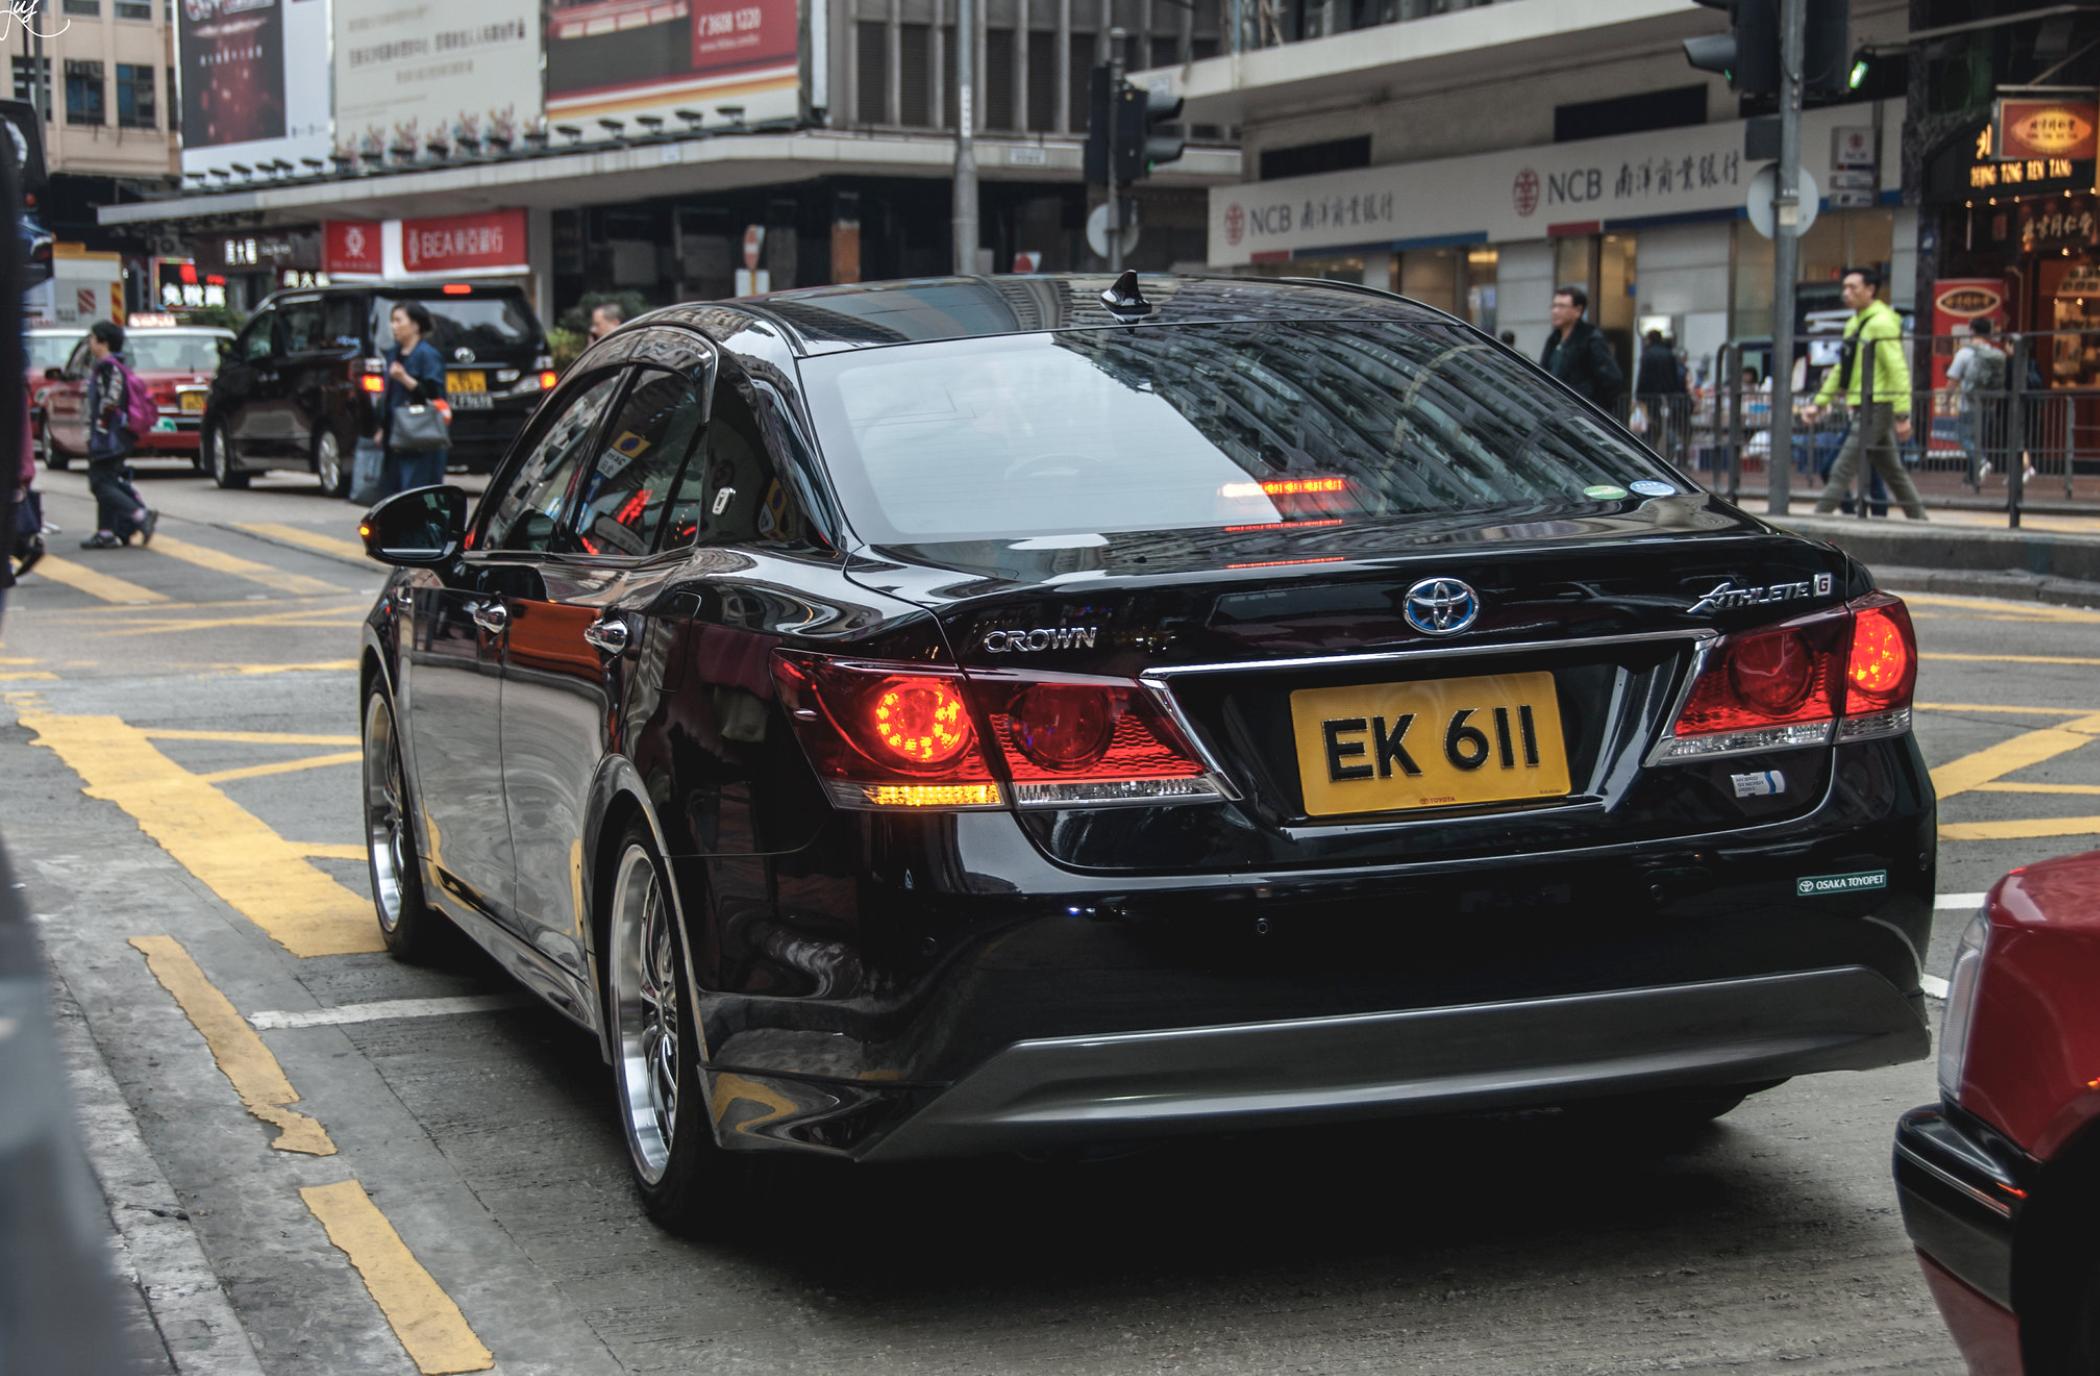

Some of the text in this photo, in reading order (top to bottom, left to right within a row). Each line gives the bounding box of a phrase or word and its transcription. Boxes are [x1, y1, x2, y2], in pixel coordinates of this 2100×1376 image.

[1547, 149, 1739, 205] NCB 南洋商業銀行
[1250, 203, 1292, 236] NCB
[421, 230, 455, 259] BEA
[1687, 582, 1810, 614] ATHLETE
[982, 626, 1097, 655] CROWN
[1321, 704, 1541, 784] EK 611
[1430, 796, 1456, 804] TOYOTA
[1815, 875, 1885, 890] OSAKA TOYOPET
